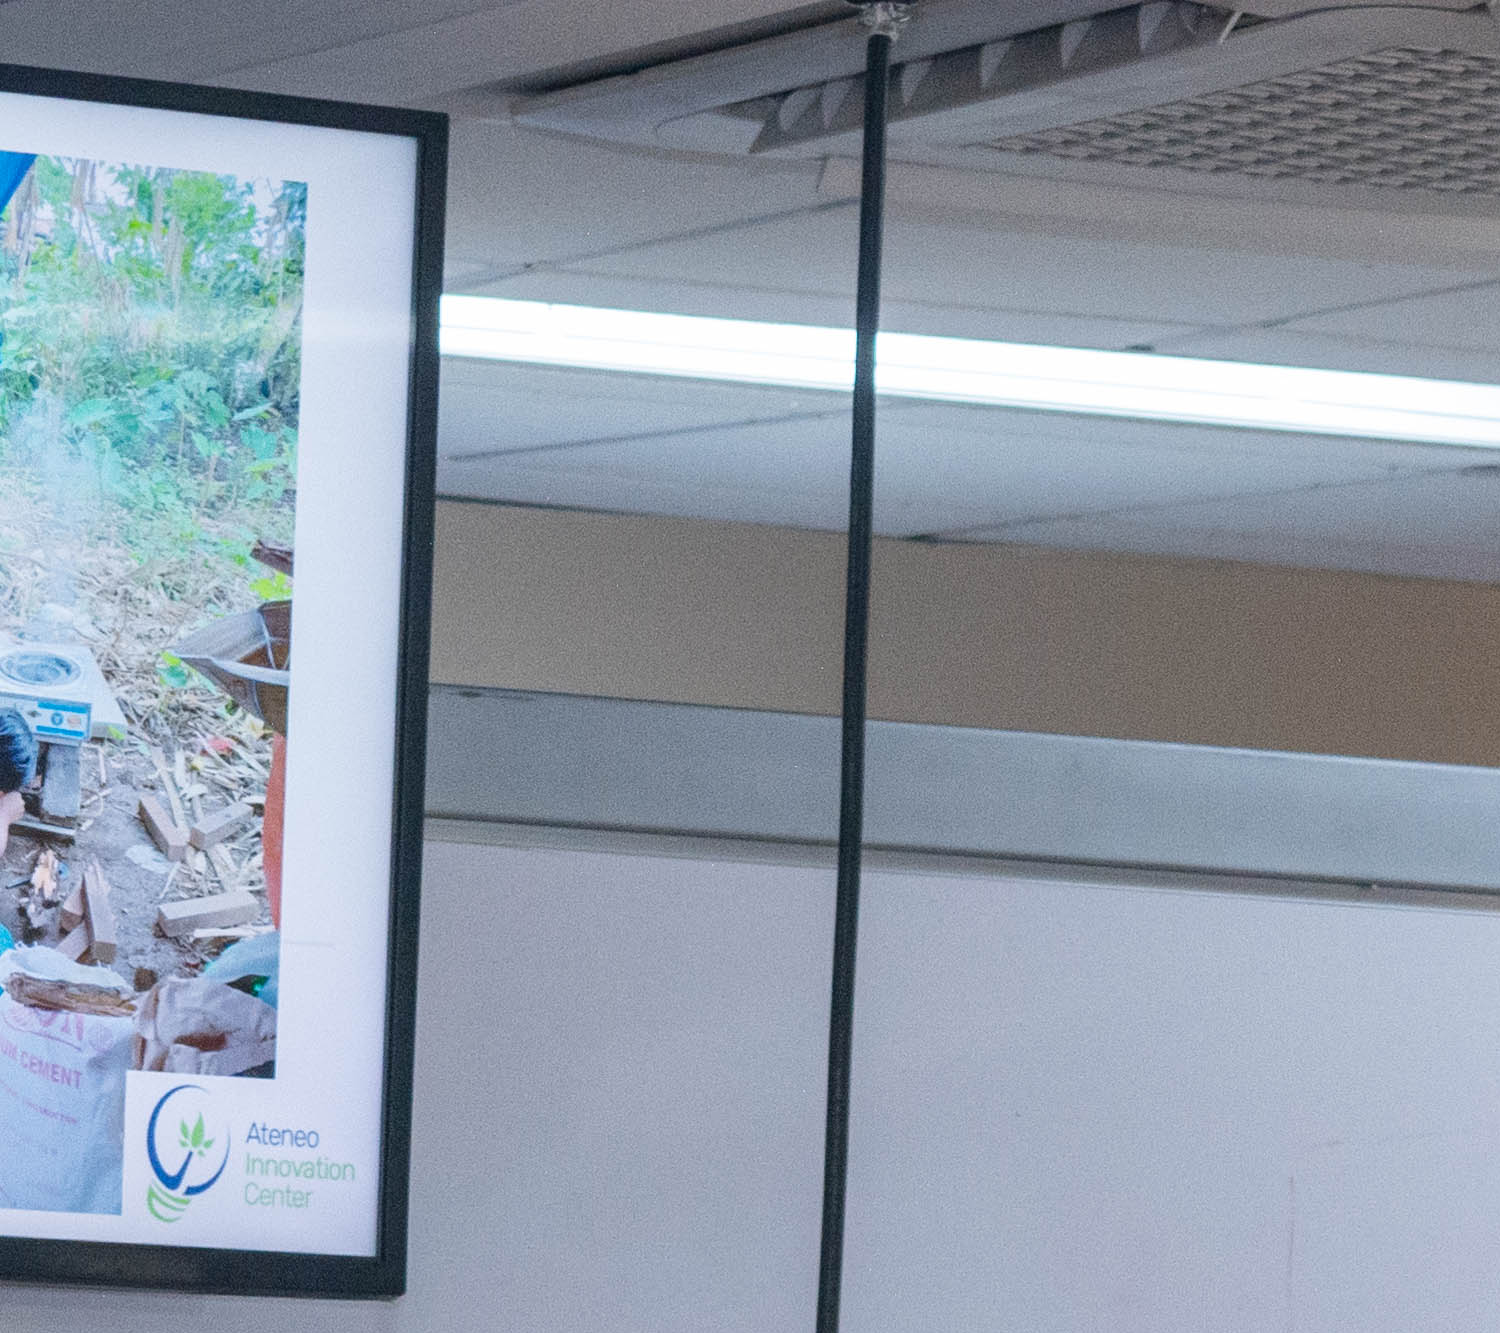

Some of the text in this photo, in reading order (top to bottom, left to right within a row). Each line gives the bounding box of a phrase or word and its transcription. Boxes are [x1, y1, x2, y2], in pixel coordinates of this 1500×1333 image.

[20, 1051, 84, 1089] CEMENT
[246, 1122, 320, 1149] Ateneo
[245, 1153, 356, 1181] Innovation
[244, 1183, 313, 1208] Center
